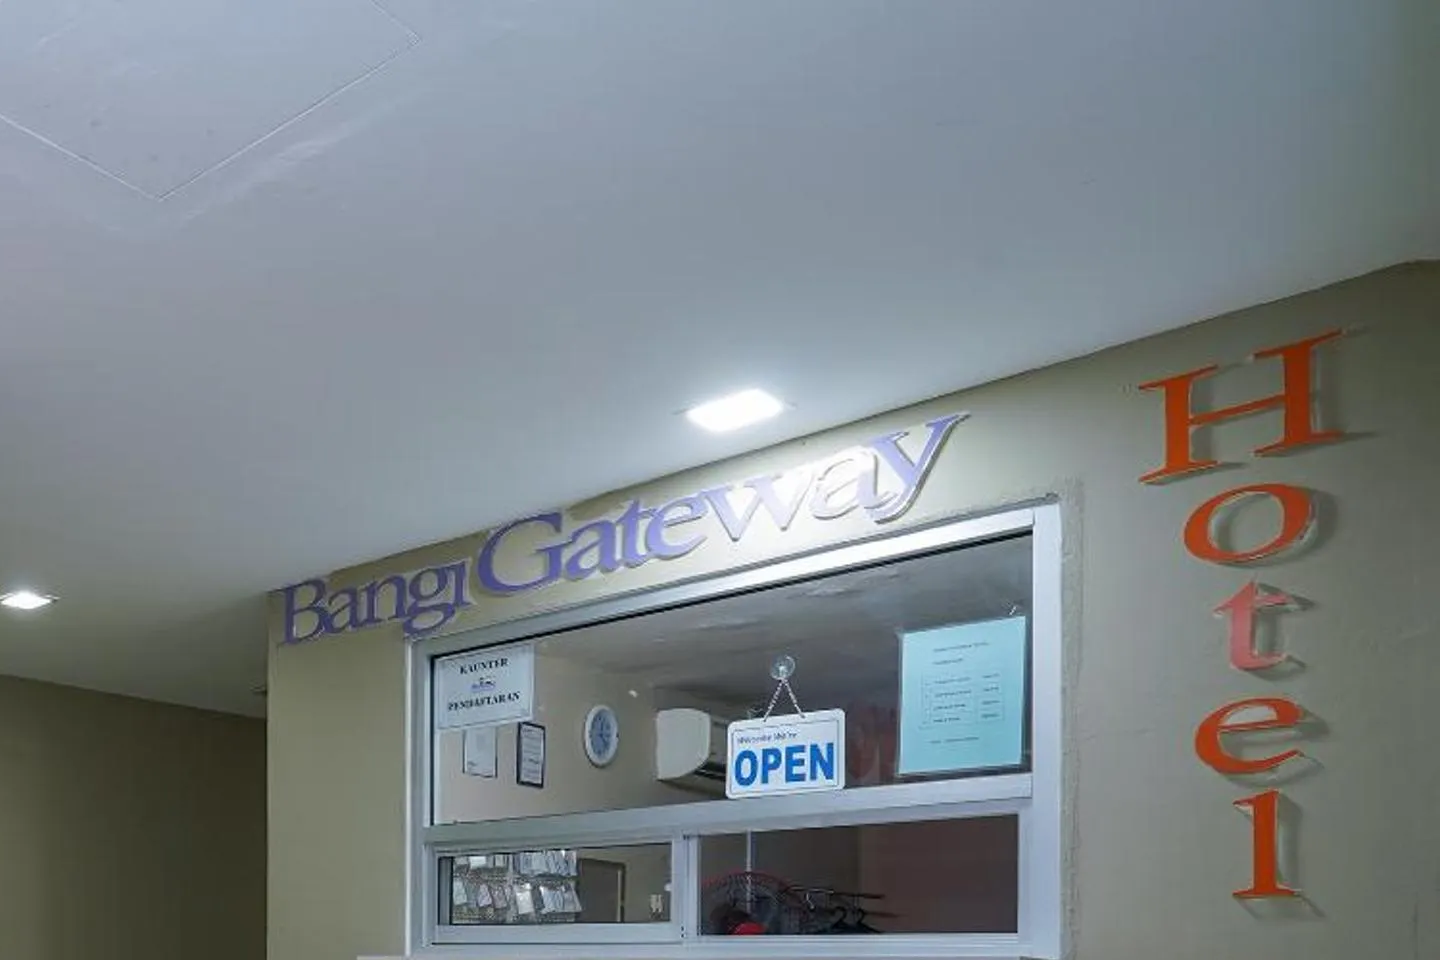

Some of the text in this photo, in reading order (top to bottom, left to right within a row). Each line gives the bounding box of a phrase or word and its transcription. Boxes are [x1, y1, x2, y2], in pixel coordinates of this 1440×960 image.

[279, 414, 970, 645] Bangi Gateway
[1138, 329, 1343, 899] Hotel
[460, 658, 509, 675] KAUNTER
[448, 690, 521, 711] PENDAFTARAN
[734, 742, 835, 786] OPEN
